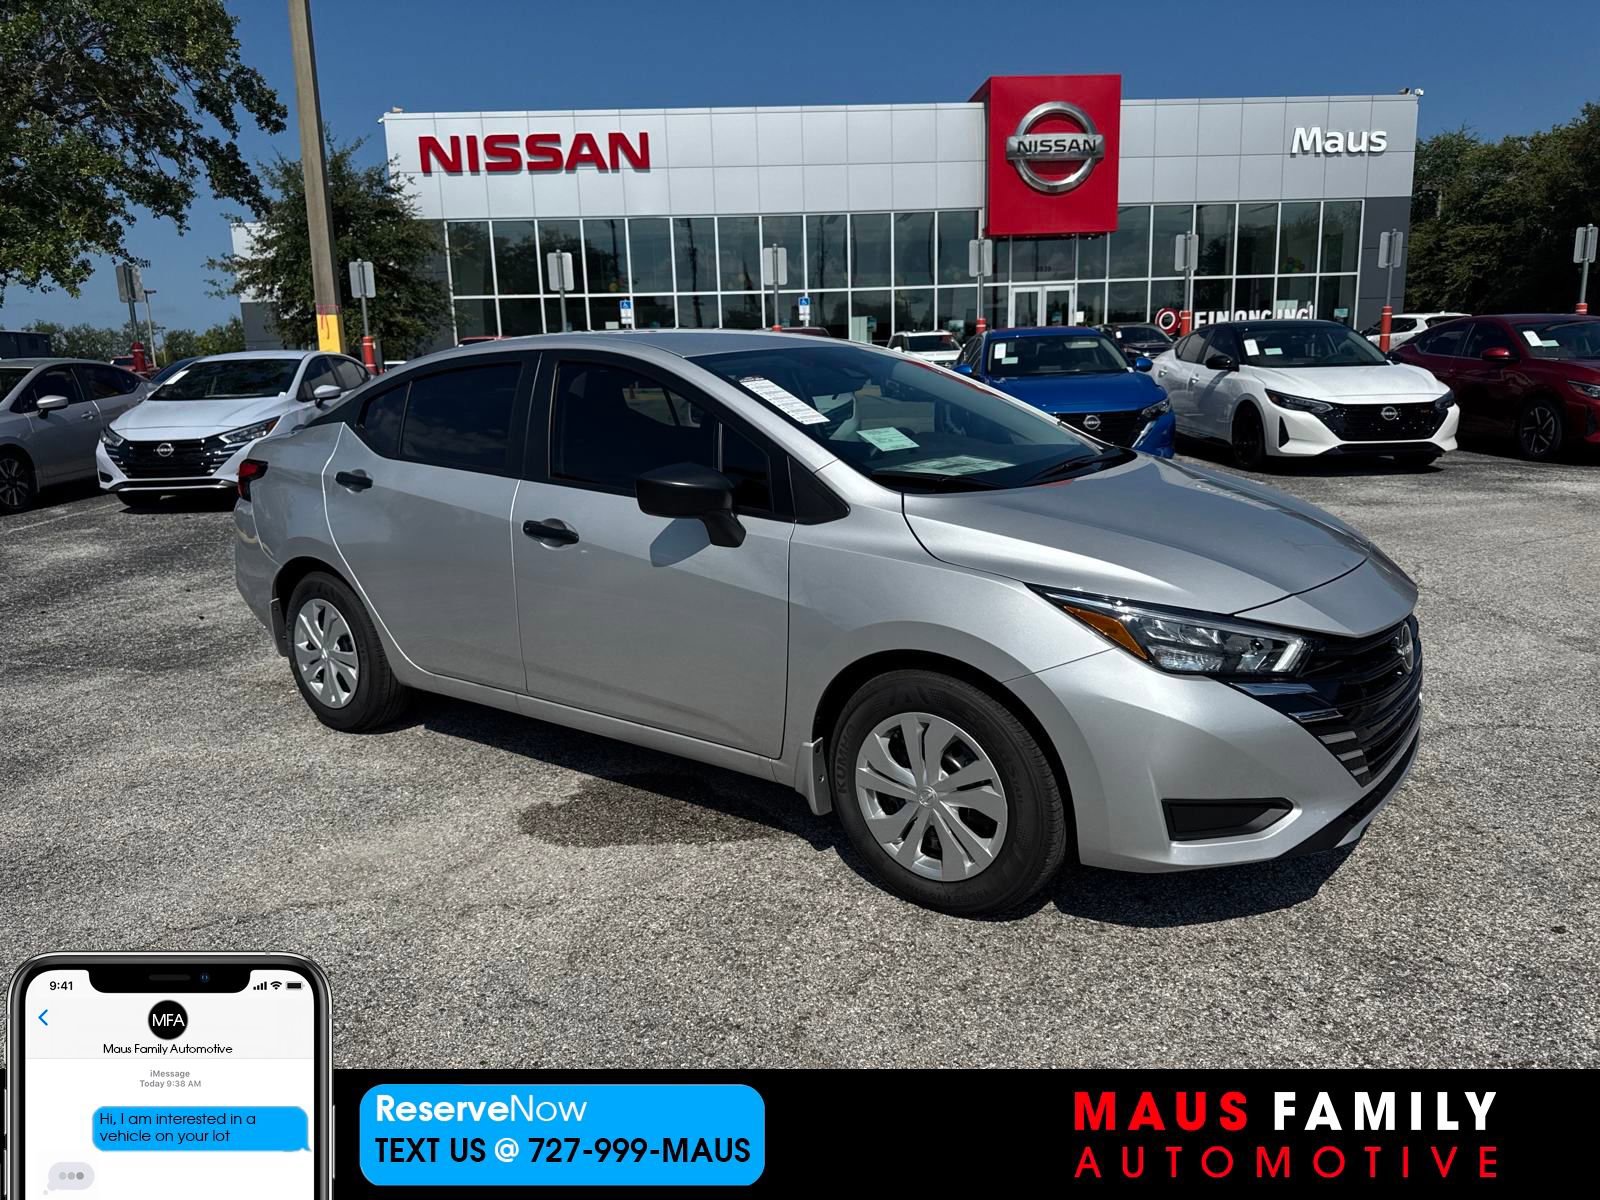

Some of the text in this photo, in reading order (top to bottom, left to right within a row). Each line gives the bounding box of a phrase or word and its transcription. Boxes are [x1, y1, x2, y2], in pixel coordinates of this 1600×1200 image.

[418, 131, 650, 175] NISSAN
[1016, 138, 1098, 154] NISSAN
[1290, 126, 1388, 154] Maus
